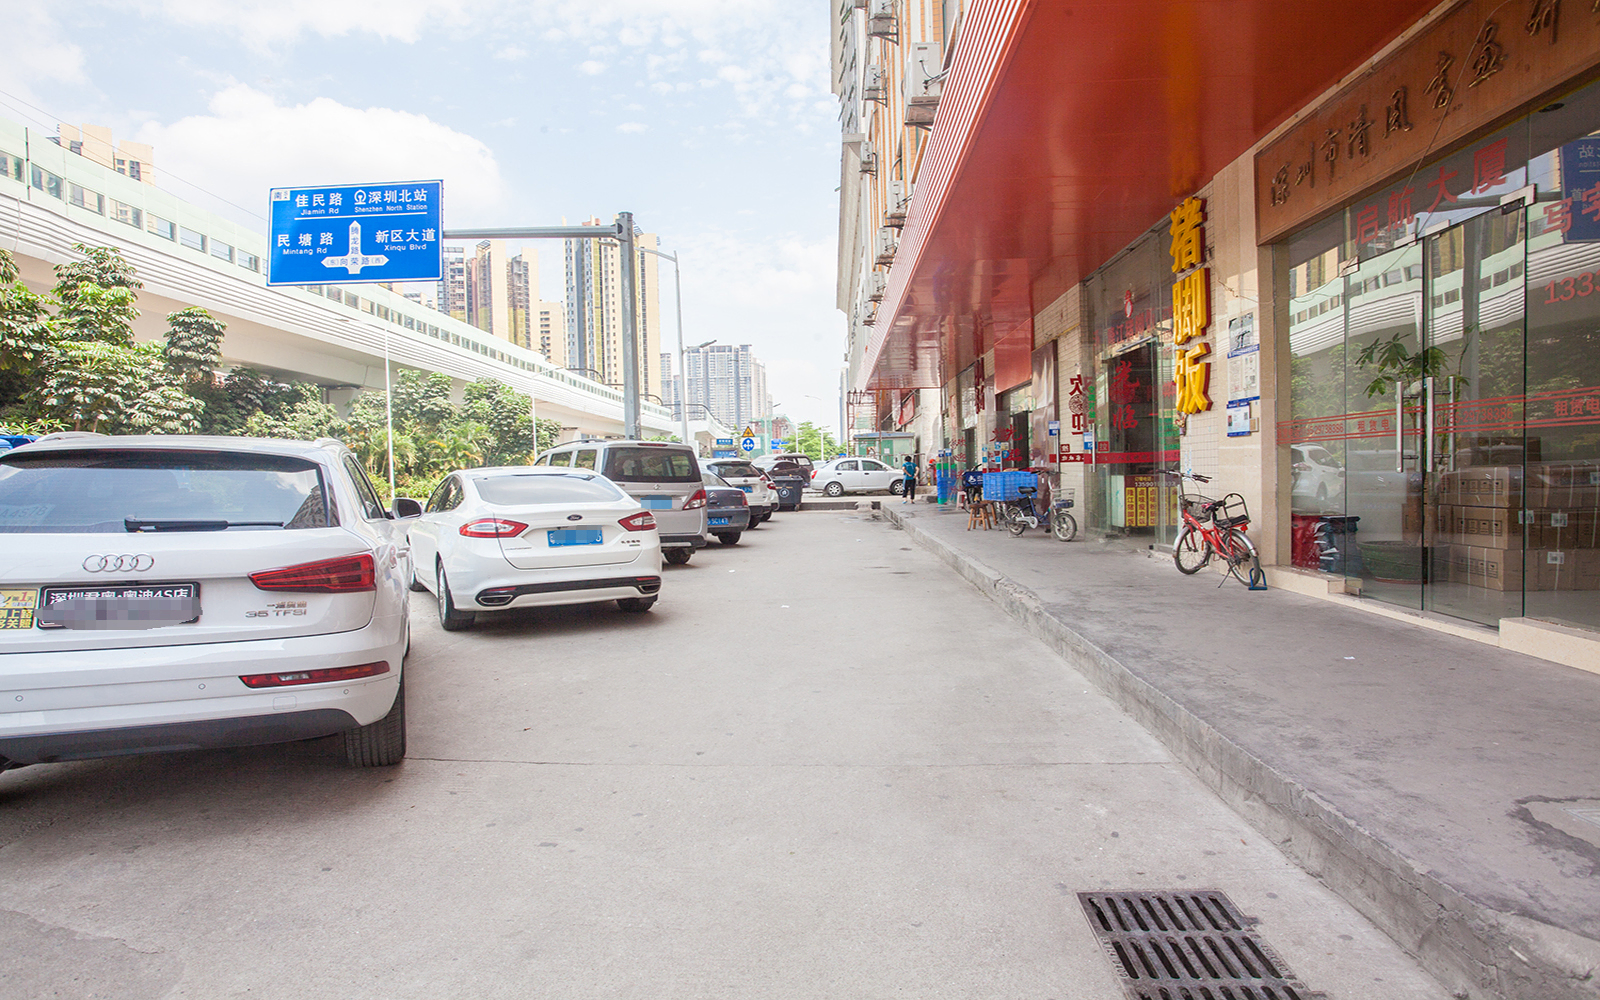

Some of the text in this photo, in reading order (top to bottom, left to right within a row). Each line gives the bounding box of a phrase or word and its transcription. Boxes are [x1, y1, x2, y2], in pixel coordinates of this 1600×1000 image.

[368, 188, 428, 204] 深圳北站
[1354, 136, 1508, 246] 启航大厦
[295, 192, 343, 208] 佳民路
[406, 203, 428, 211] Station
[277, 232, 334, 247] 民塘路
[375, 228, 436, 243] 新区大道
[409, 243, 427, 251] Blvd
[245, 610, 269, 618] 35
